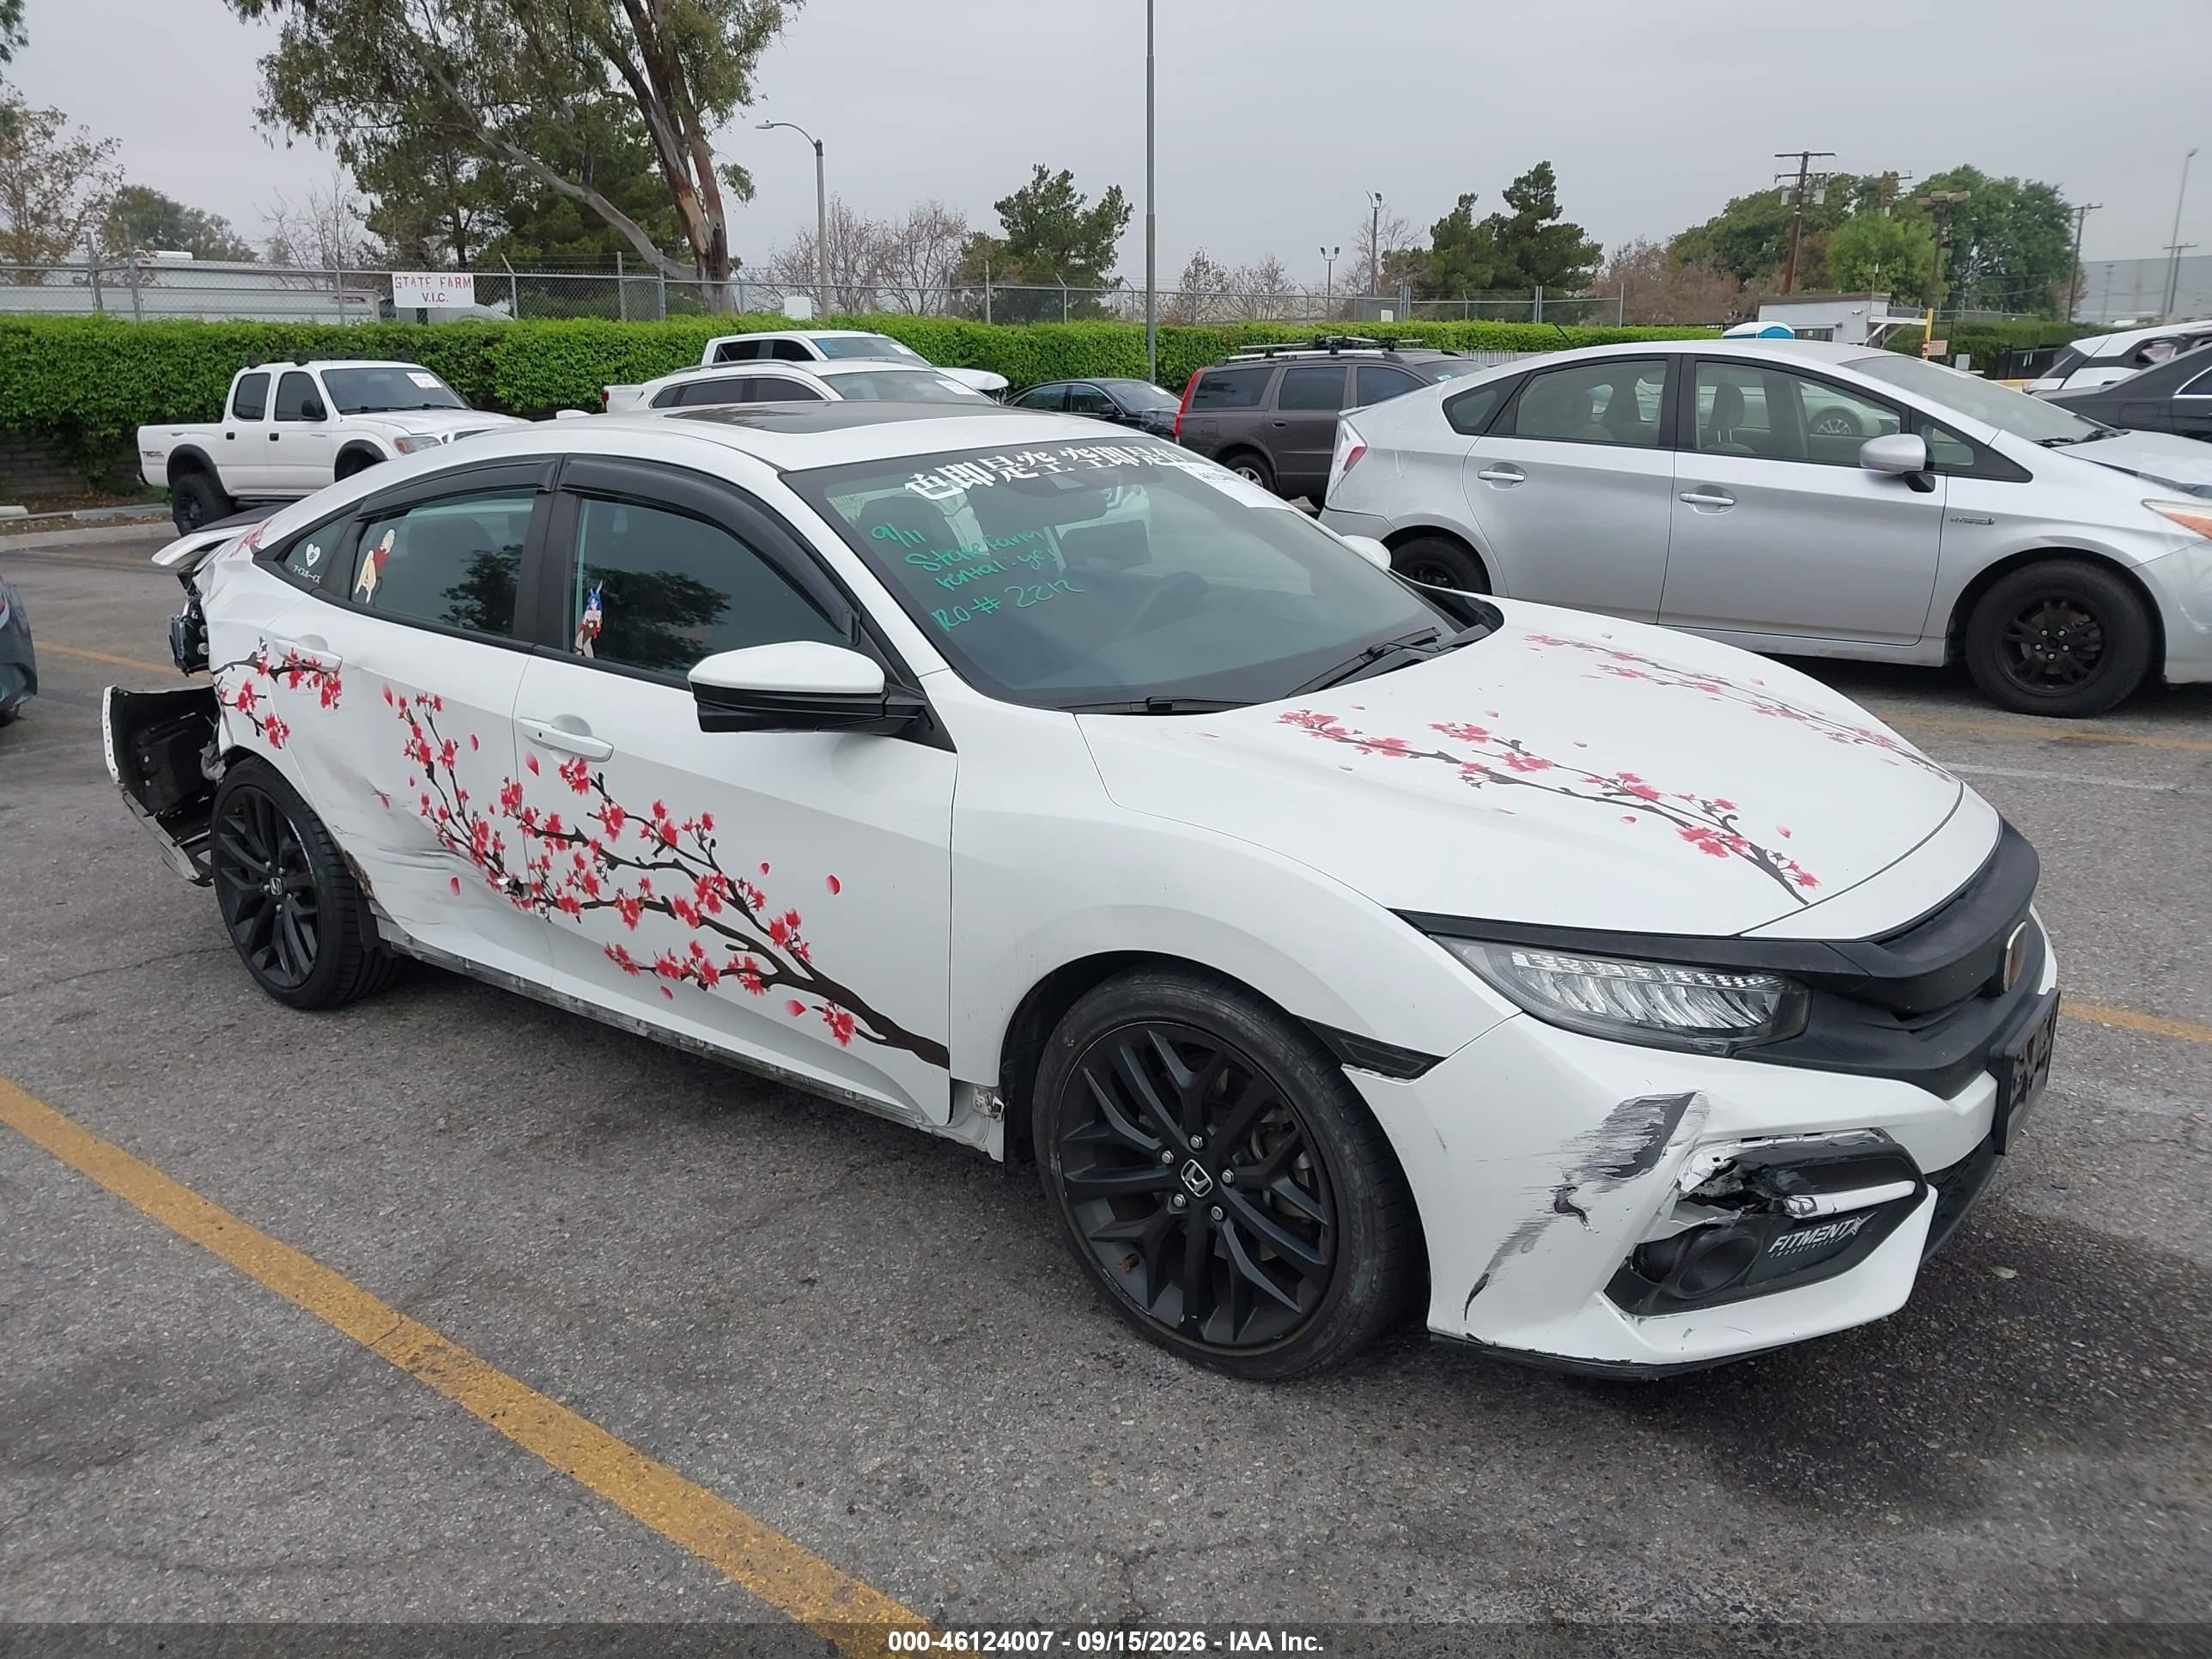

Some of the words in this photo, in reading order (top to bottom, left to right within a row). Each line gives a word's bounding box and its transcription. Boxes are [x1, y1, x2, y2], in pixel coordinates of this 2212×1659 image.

[395, 276, 432, 289] STATE
[440, 276, 471, 289] FARM
[422, 292, 449, 302] V.I.C.
[871, 522, 927, 548] 9/11
[1768, 1218, 1857, 1253] FITMENT
